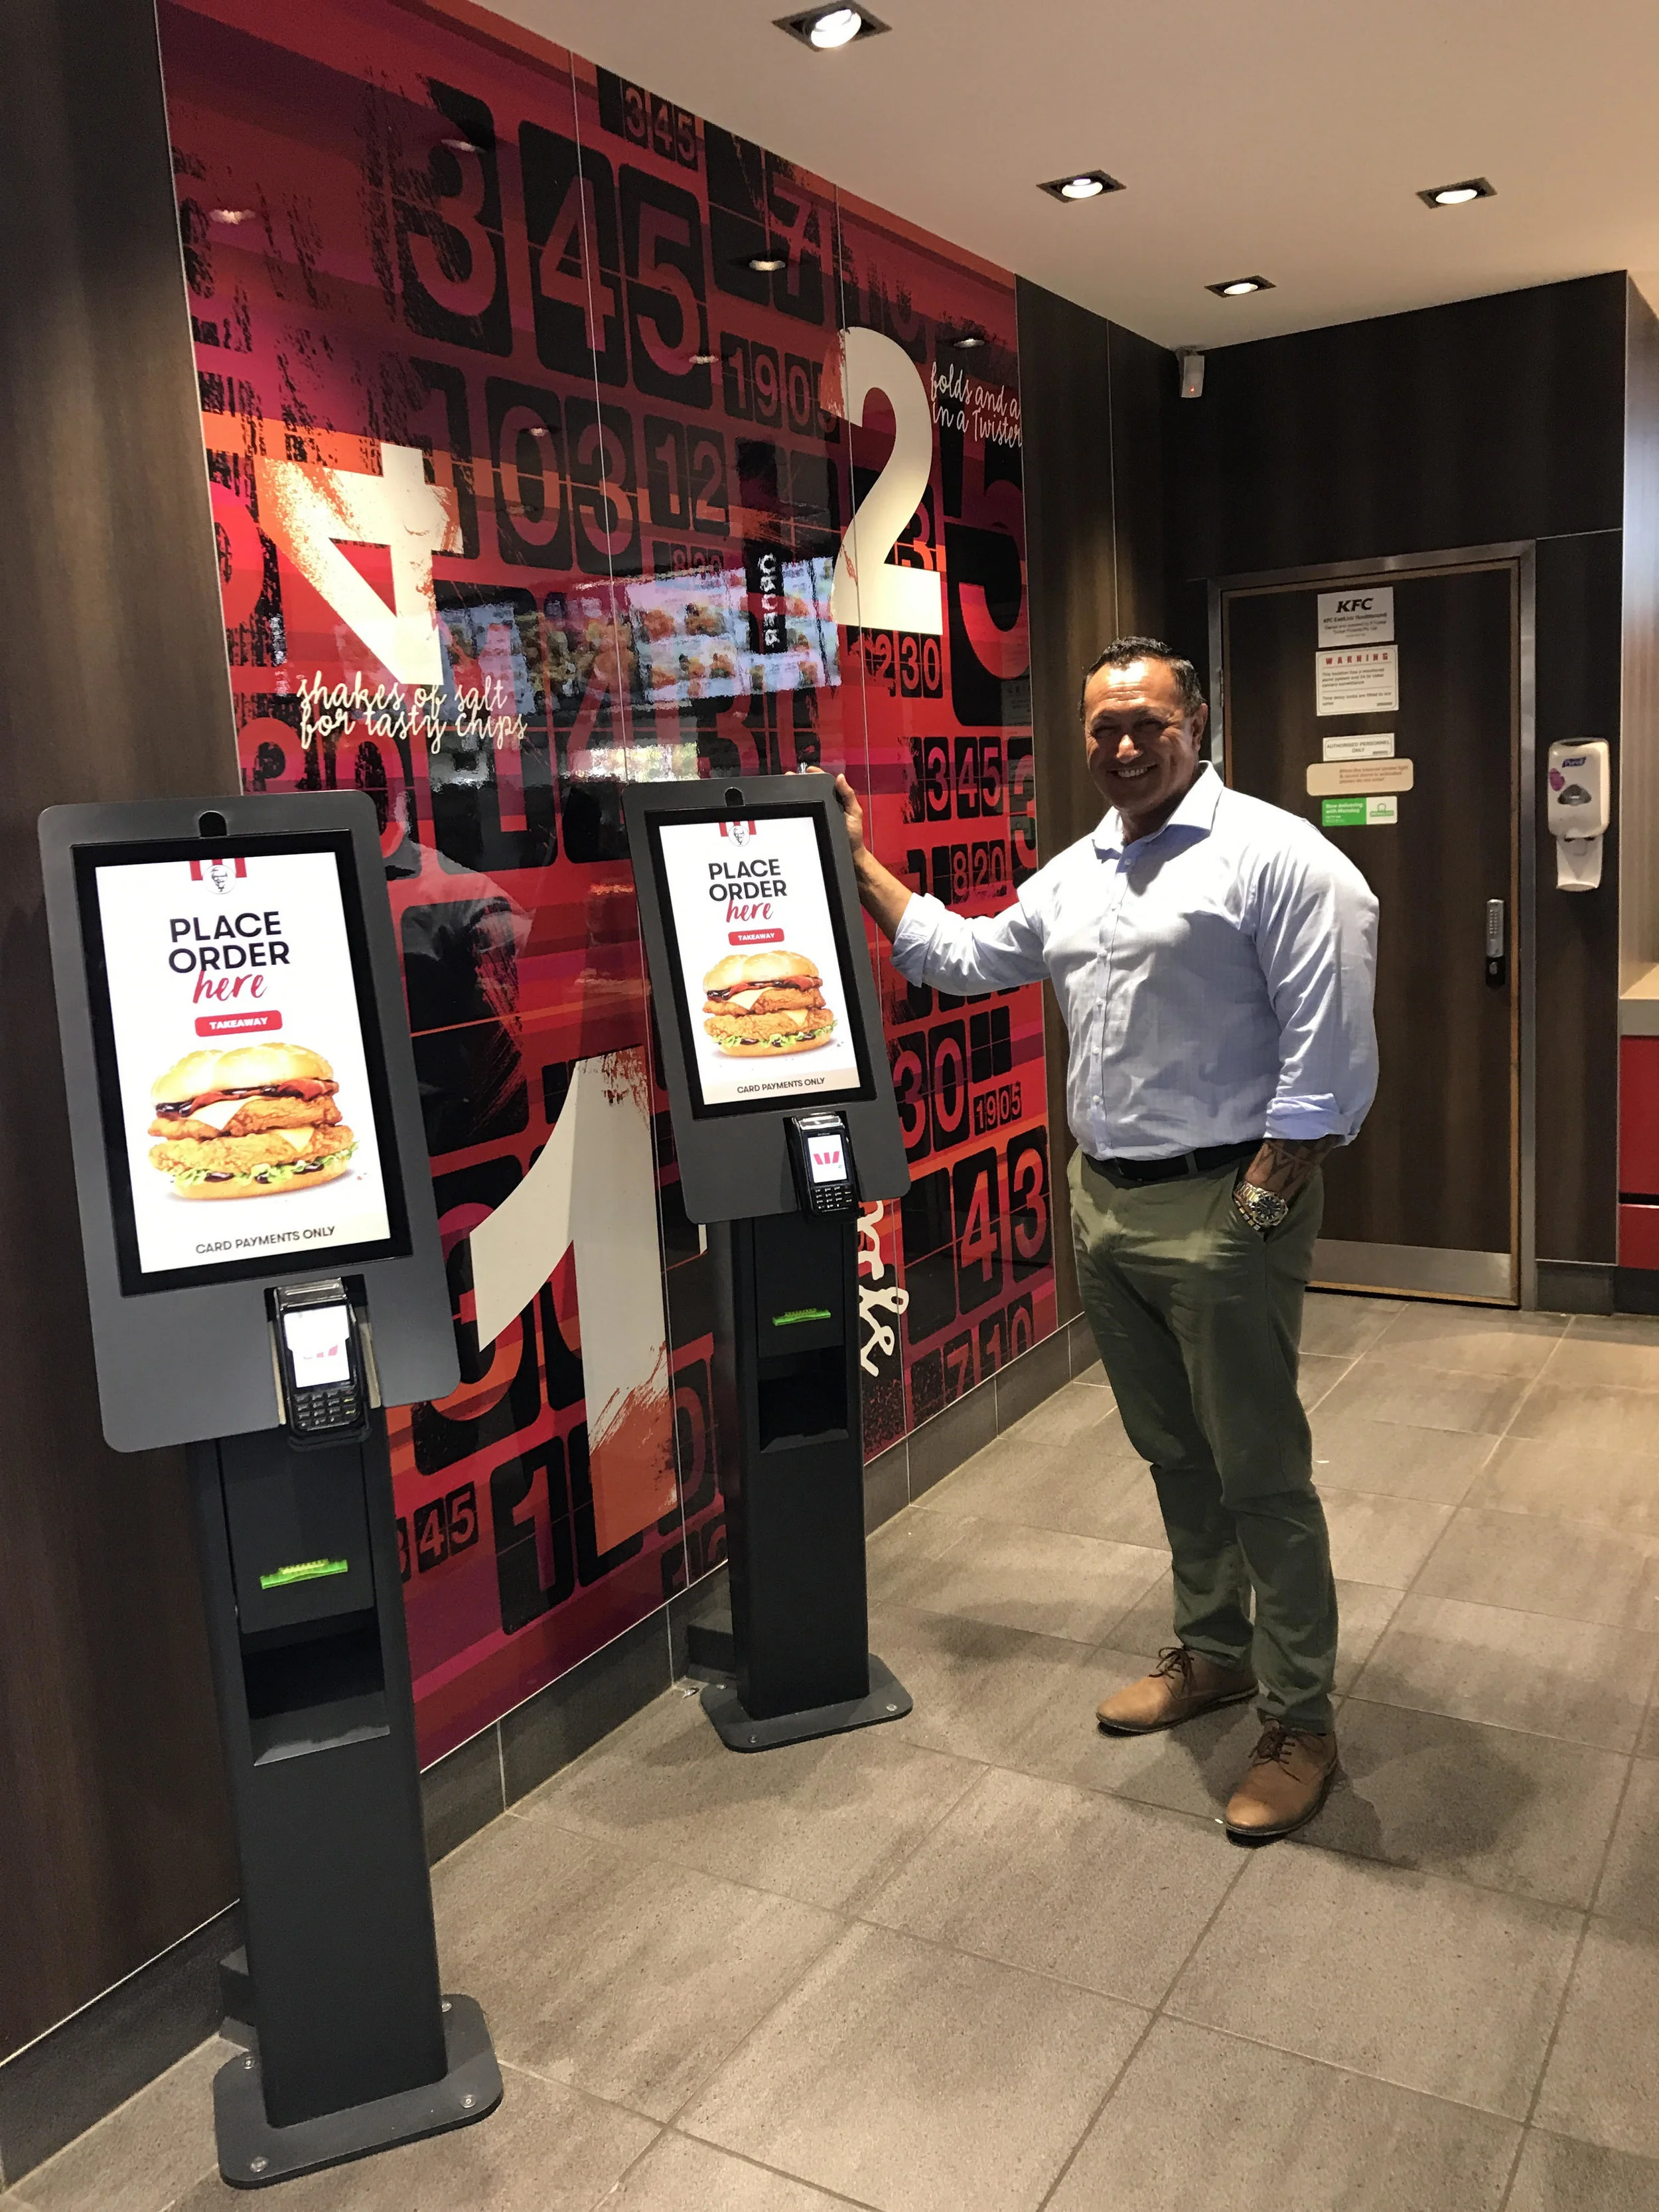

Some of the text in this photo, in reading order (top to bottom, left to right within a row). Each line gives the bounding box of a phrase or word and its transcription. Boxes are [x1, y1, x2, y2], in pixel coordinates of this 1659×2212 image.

[975, 385, 1007, 416] and
[957, 410, 970, 433] a
[972, 407, 1023, 448] Twister
[823, 326, 942, 636] 2
[260, 438, 463, 686] 4
[1336, 598, 1374, 613] KFC
[1326, 653, 1388, 664] WARNING
[297, 670, 508, 720] shakes of salt
[301, 703, 528, 754] for tasty chips
[928, 747, 1001, 811] 345
[709, 858, 782, 881] PLACE
[709, 879, 788, 901] ORDER
[169, 911, 282, 942] PLACE
[726, 900, 774, 923] here
[738, 932, 775, 942] TAKEAWAY
[168, 941, 290, 973] ORDER
[192, 969, 267, 1003] here
[209, 1017, 268, 1030] TAKEAWAY
[737, 1076, 825, 1094] CARD PAYMENTS ONLY
[960, 1148, 1048, 1282] 43
[196, 1226, 335, 1254] CARD PAYMENTS ONLY
